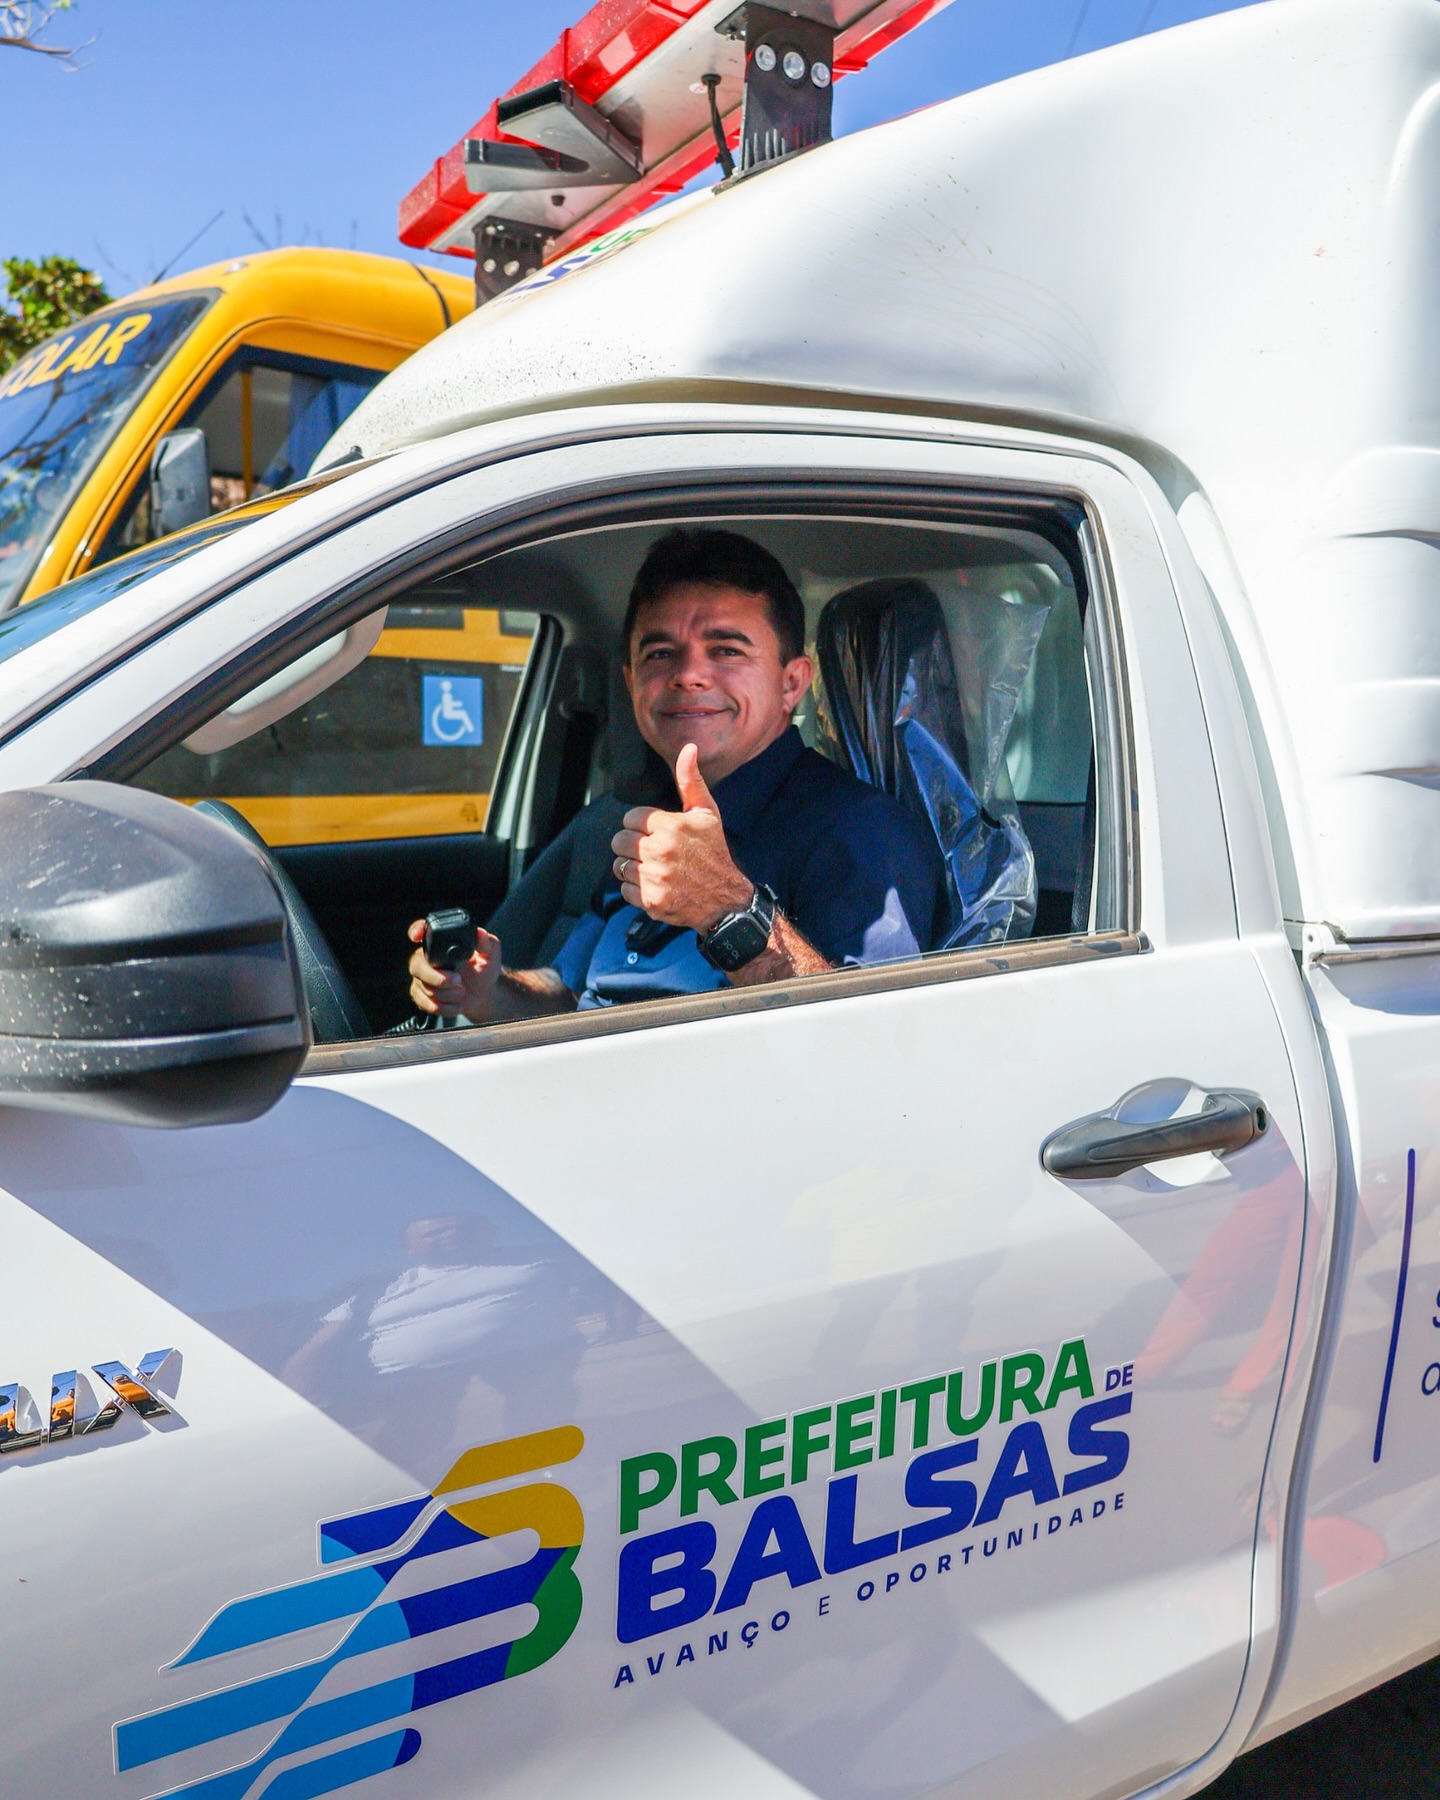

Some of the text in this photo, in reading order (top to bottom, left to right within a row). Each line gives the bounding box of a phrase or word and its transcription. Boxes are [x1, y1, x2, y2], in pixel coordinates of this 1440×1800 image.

[616, 1391, 1133, 1645] BALSAS
[620, 1338, 1134, 1535] PREFEITURA DE
[613, 1492, 1125, 1689] AVANÇO E OPORTUNIDADE
